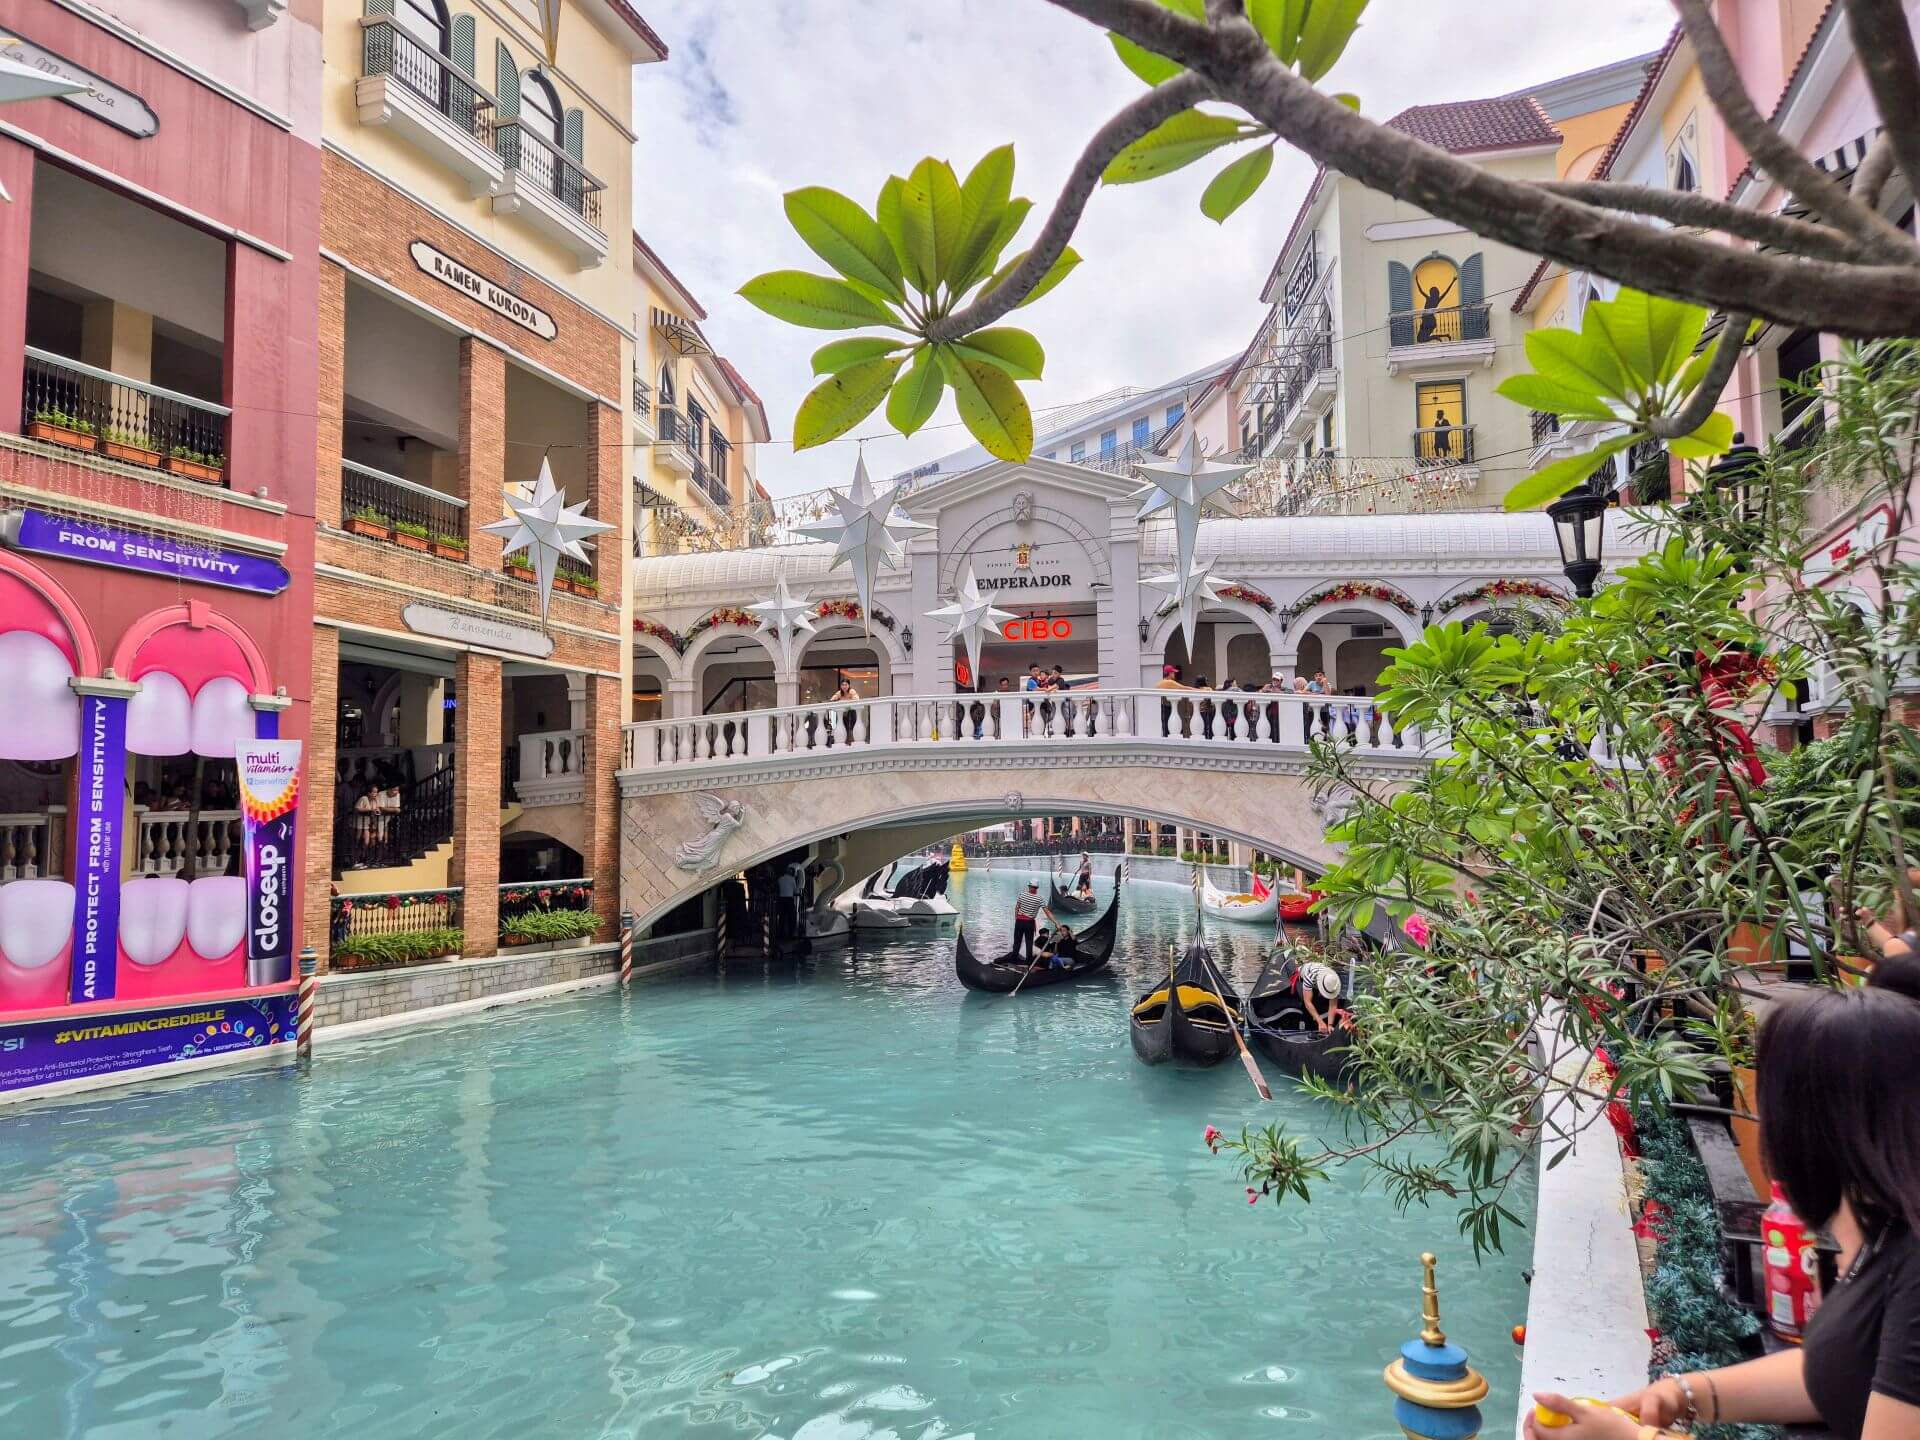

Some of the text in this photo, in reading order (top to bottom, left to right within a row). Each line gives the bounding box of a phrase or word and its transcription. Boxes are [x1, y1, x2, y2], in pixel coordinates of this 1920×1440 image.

[434, 257, 537, 327] RAMEN KURODA
[58, 530, 240, 575] FROM SENSITIVITY
[977, 574, 1072, 590] EMPERADOR
[1003, 618, 1073, 641] CIBO
[246, 752, 280, 764] multi
[84, 699, 106, 998] AND PROTECT FROM SENSITIVITY
[255, 844, 286, 951] closeup
[55, 1010, 225, 1044] #VITAMINCREDIBLE
[0, 1037, 24, 1052] SI
